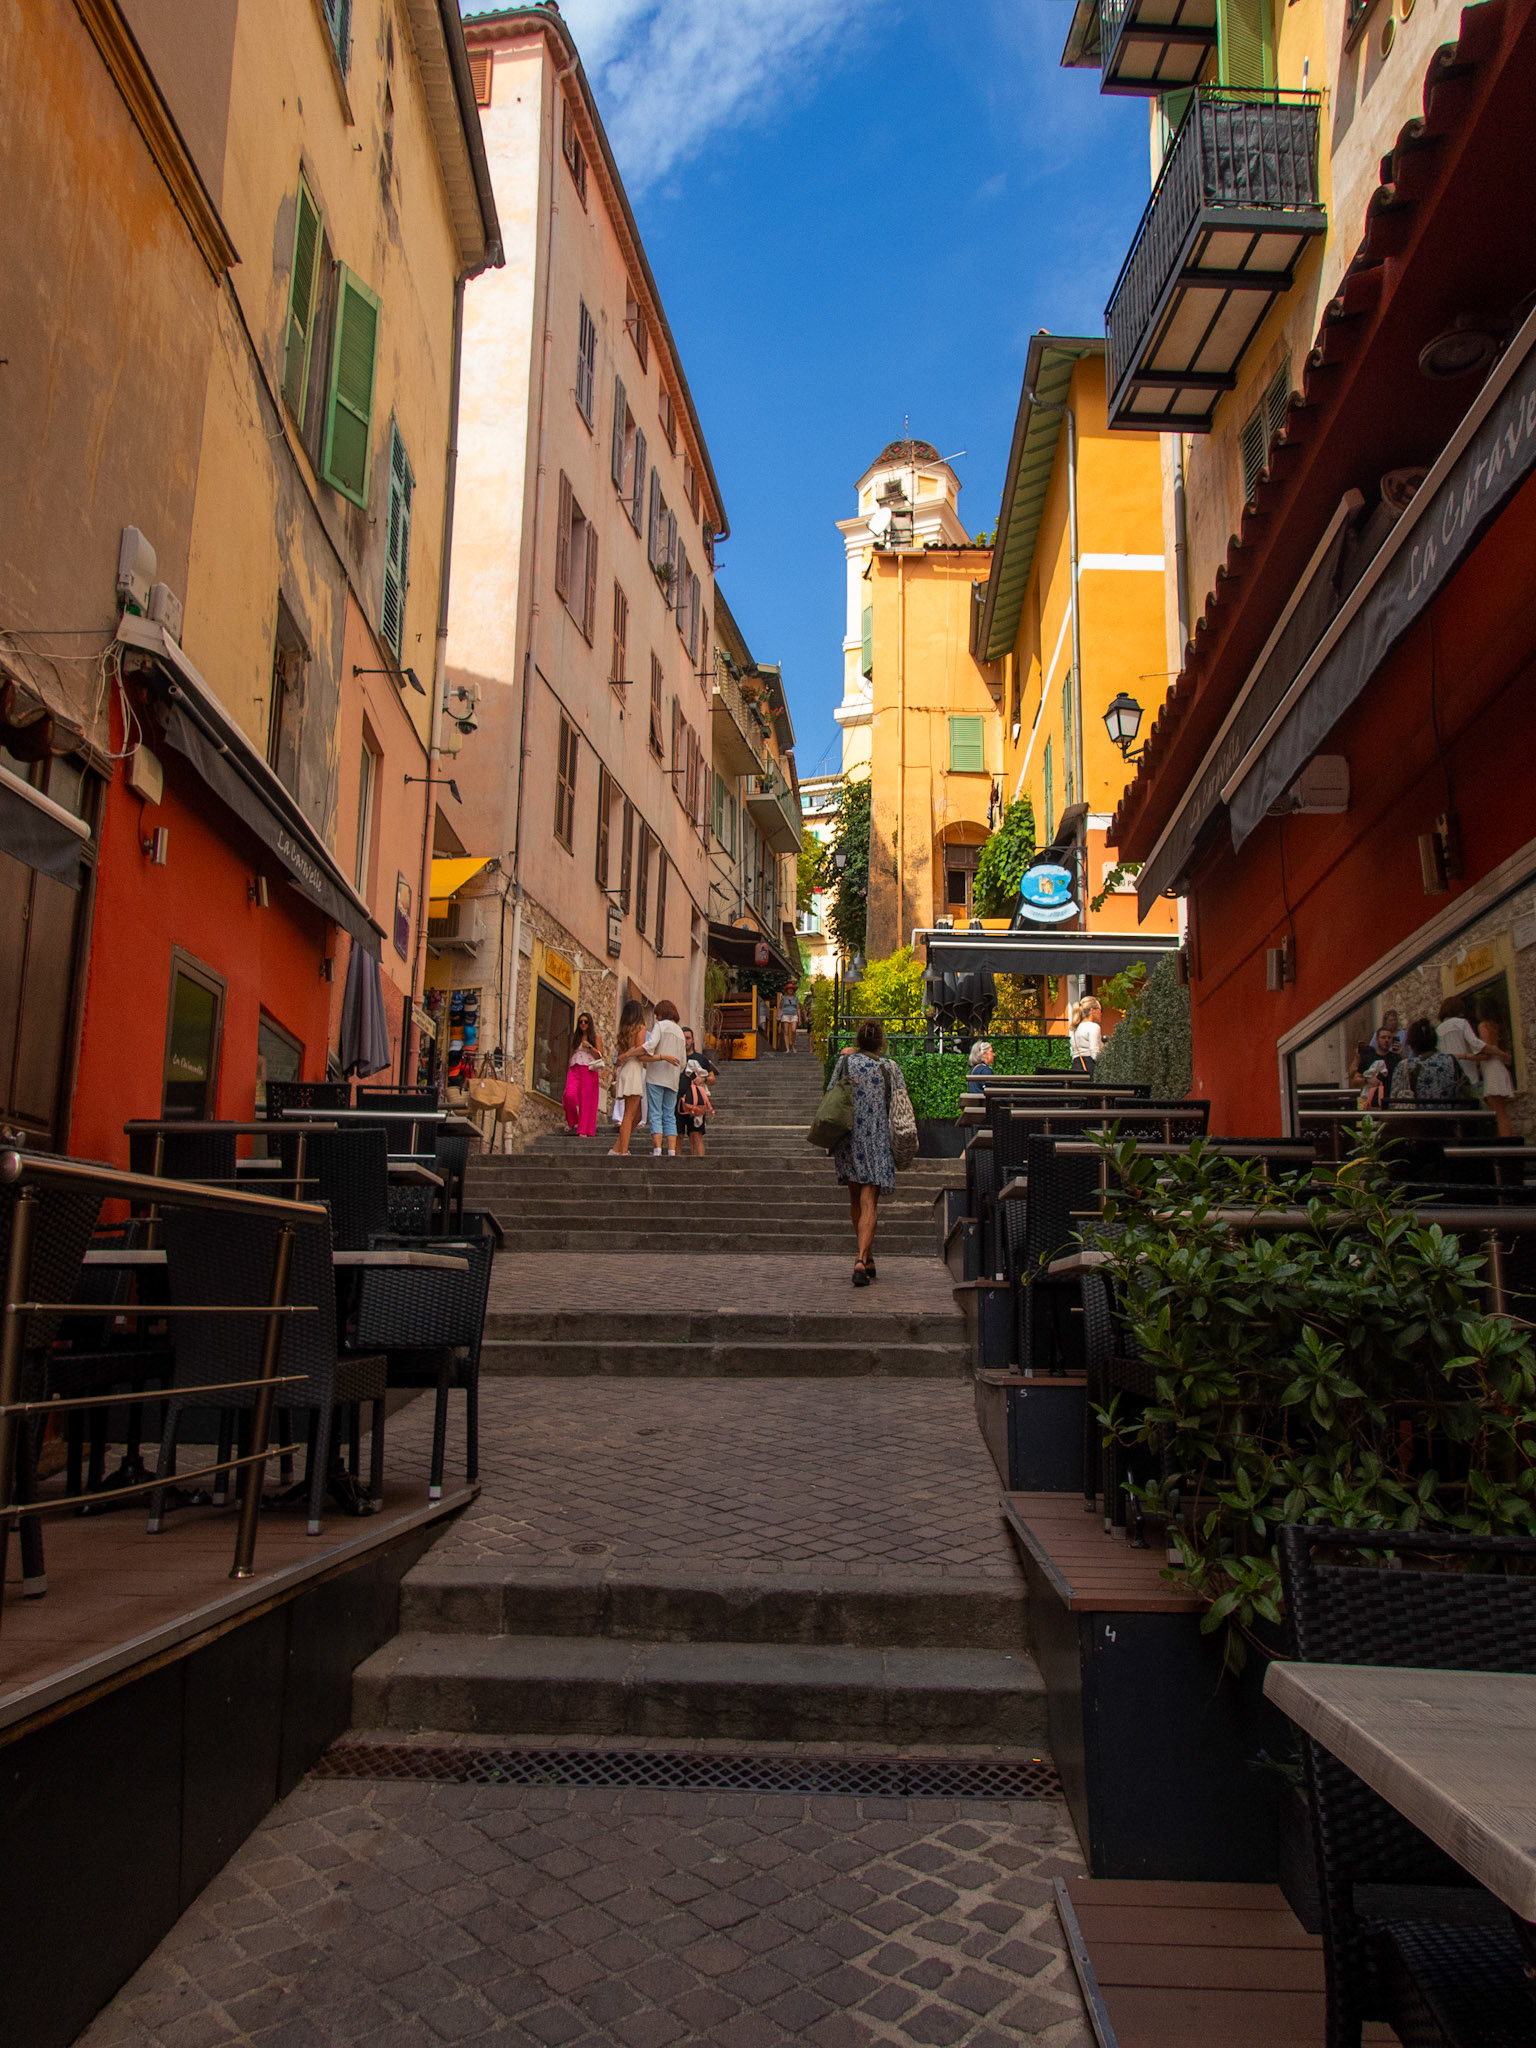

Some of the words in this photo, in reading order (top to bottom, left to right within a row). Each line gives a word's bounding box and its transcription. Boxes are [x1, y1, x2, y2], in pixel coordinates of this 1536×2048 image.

[1407, 534, 1437, 601] La
[277, 829, 290, 855] La
[290, 844, 322, 893] Caravelle
[1105, 1624, 1117, 1643] 4
